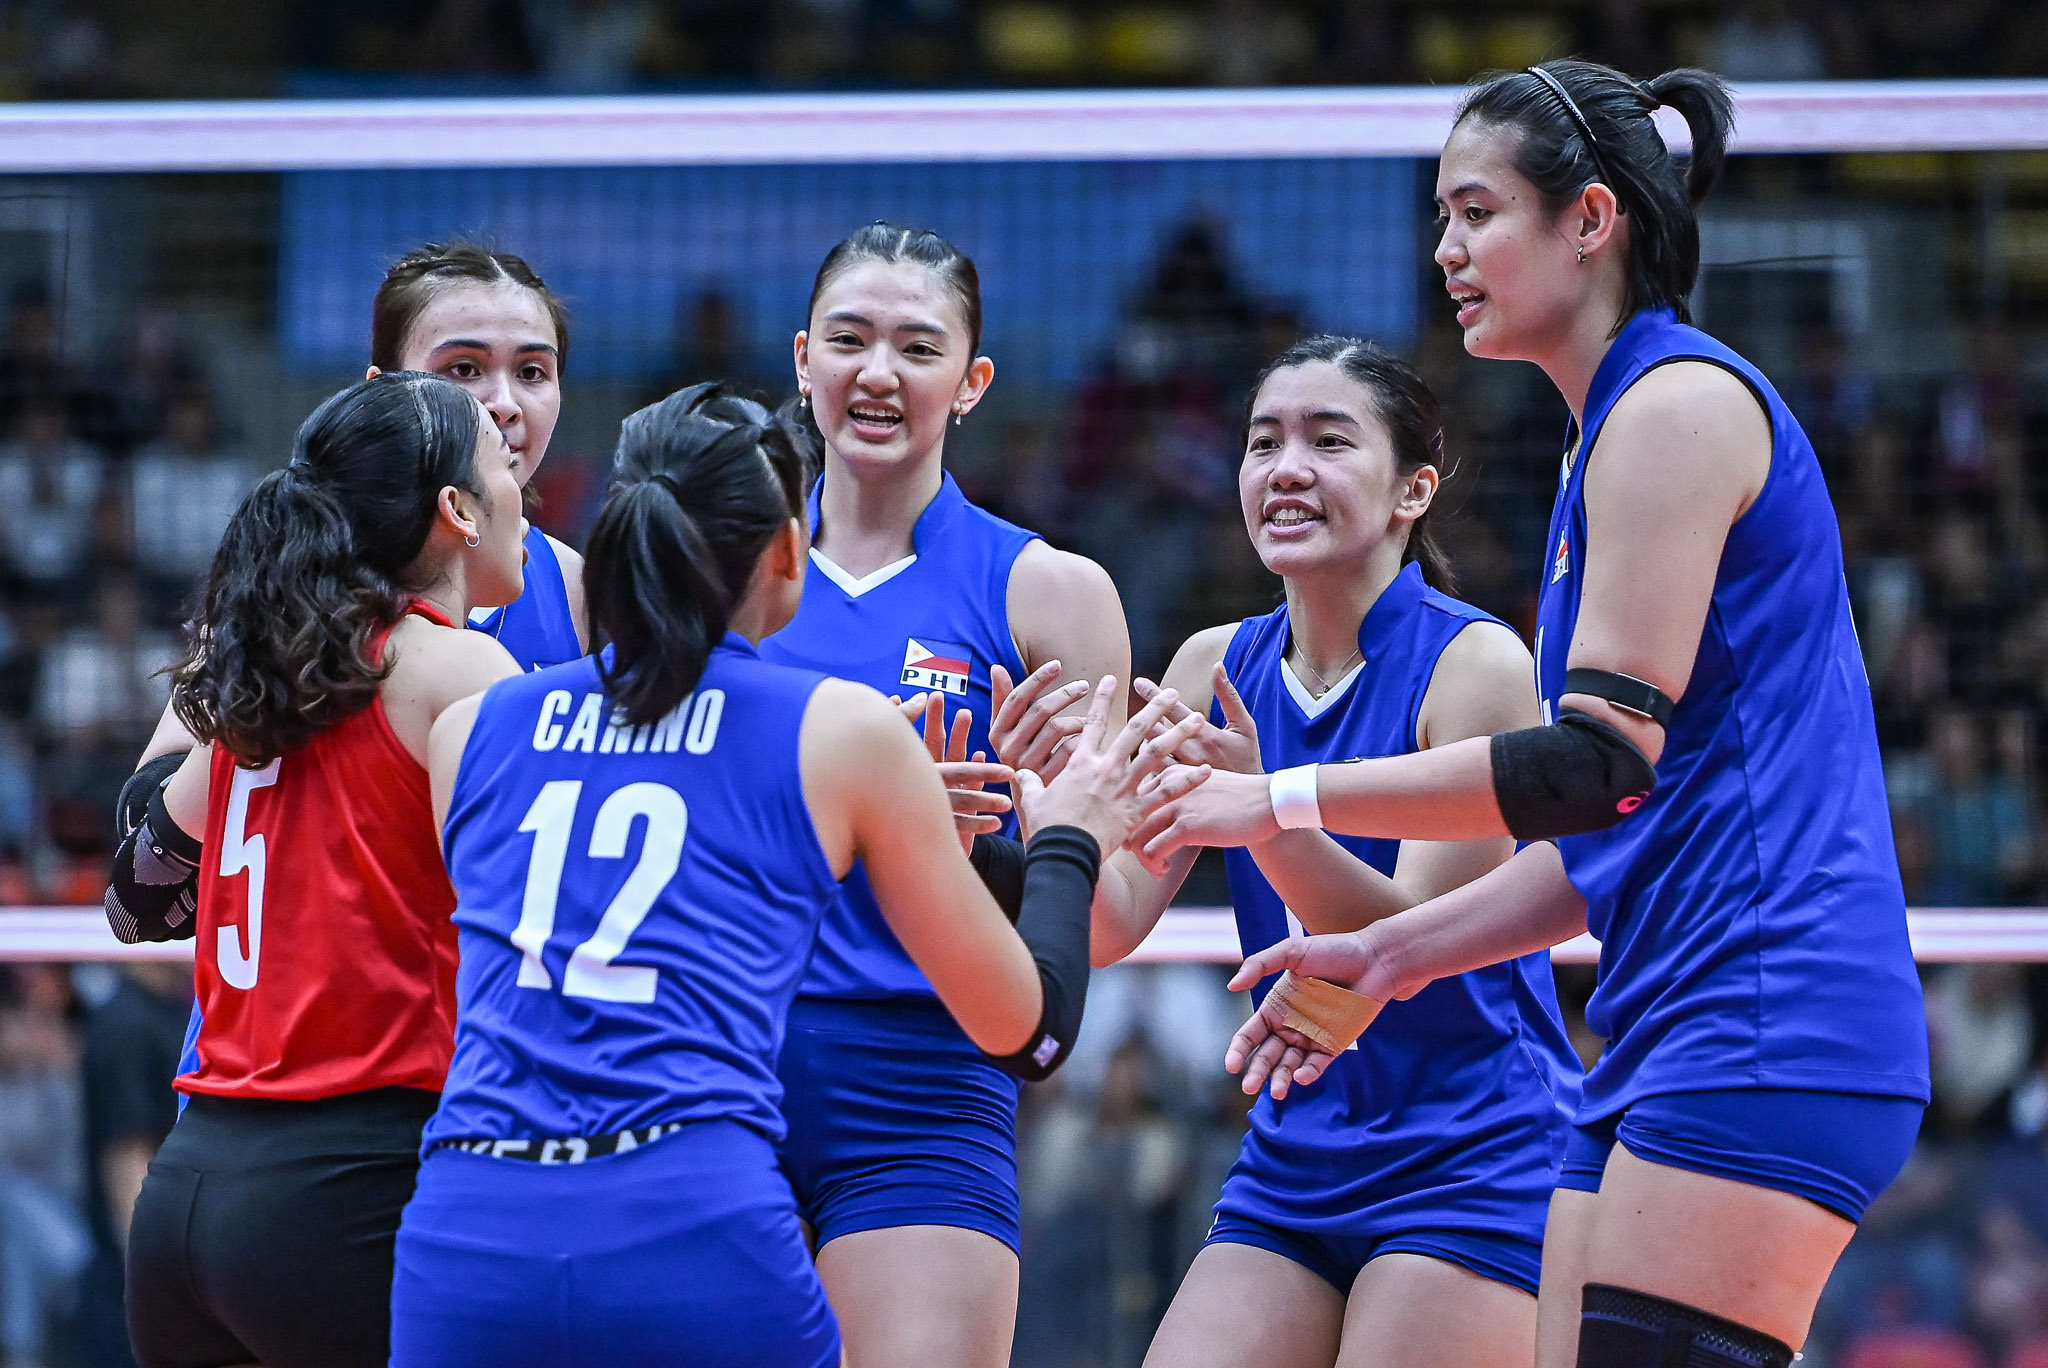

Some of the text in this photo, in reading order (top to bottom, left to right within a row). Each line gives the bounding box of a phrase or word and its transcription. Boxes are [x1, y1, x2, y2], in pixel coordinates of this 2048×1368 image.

[901, 668, 967, 693] PHI
[217, 756, 283, 990] 5
[510, 779, 689, 1003] 12
